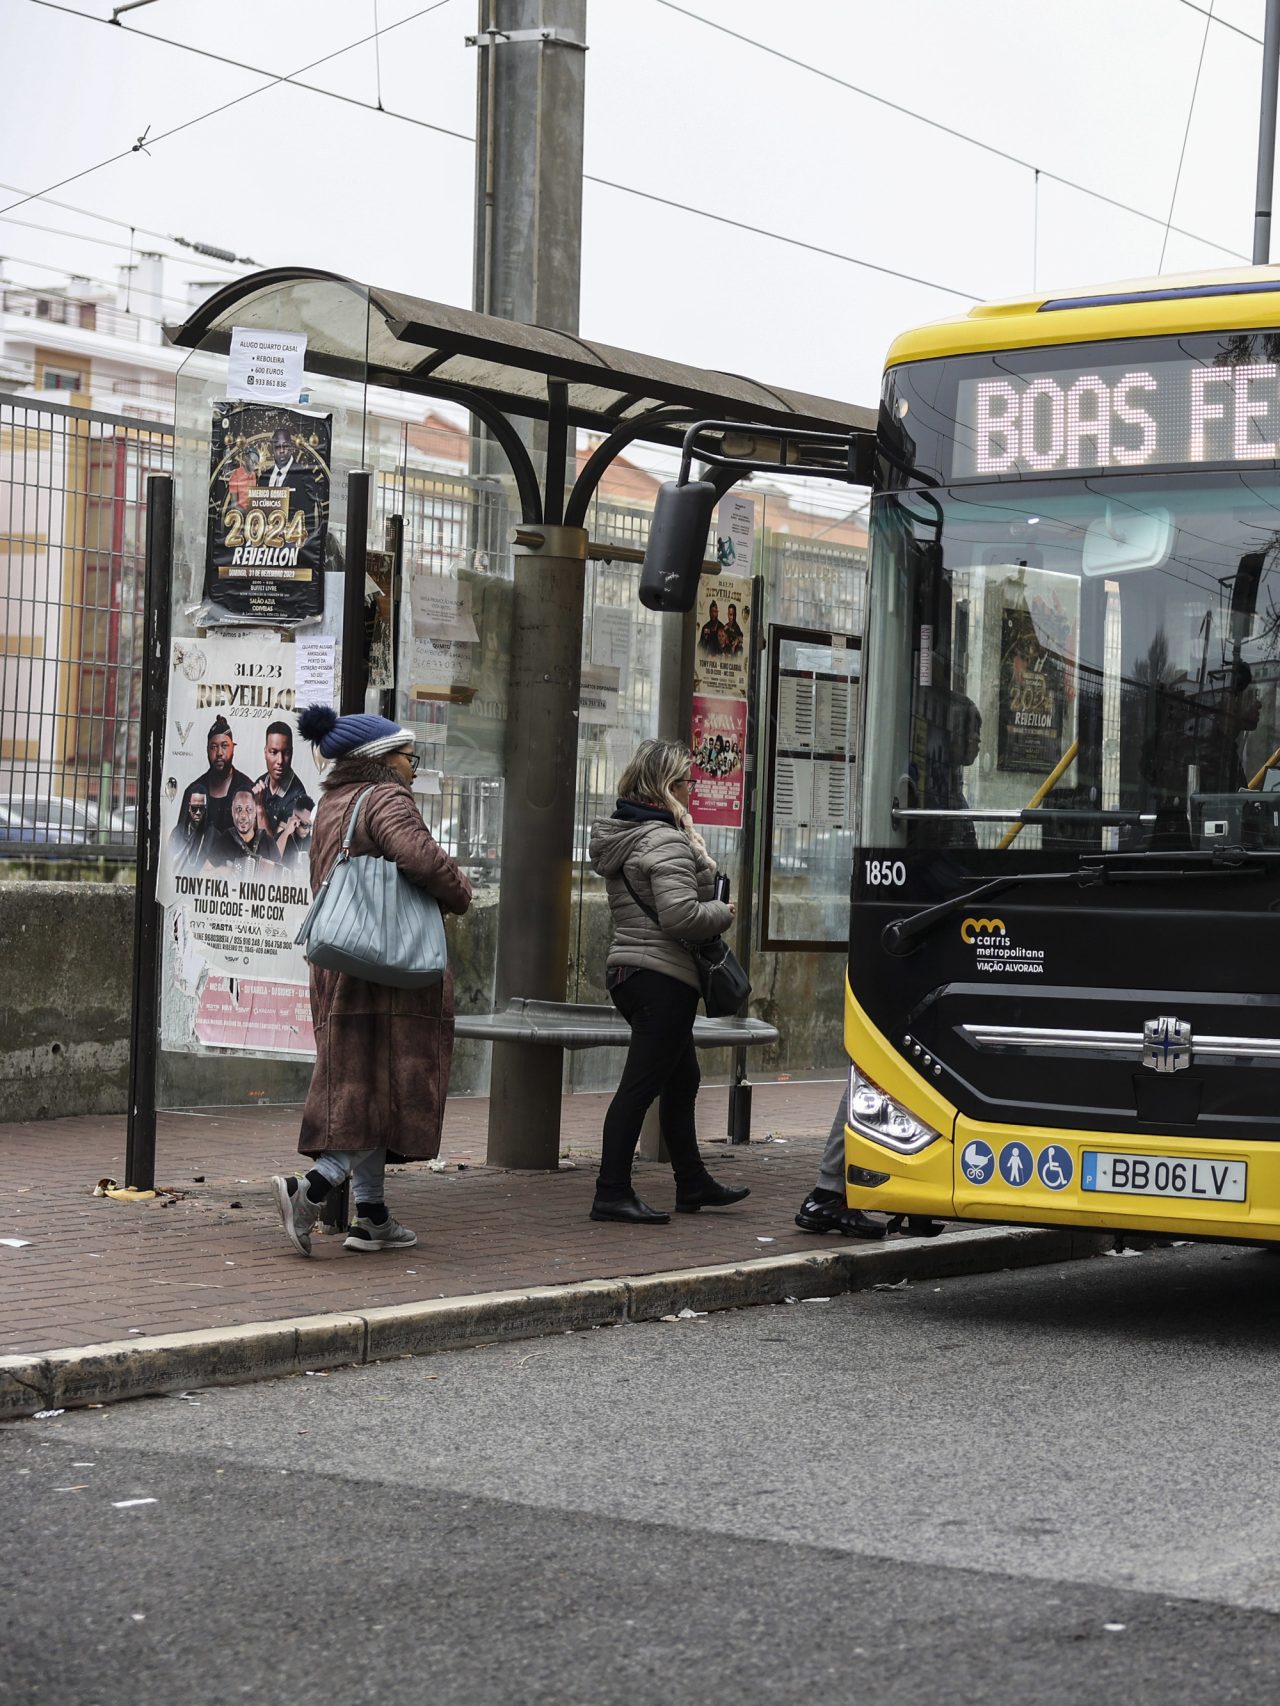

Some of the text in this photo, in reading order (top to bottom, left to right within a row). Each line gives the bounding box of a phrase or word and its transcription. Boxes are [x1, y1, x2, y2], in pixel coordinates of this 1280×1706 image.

[240, 341, 298, 352] ALUGO QUARTO CASAL
[256, 355, 285, 364] REBOLEIRA
[266, 368, 284, 376] EUROS
[976, 372, 1157, 472] BOAS
[224, 509, 308, 547] 2024
[234, 663, 282, 678] 31.12.23
[196, 683, 297, 713] REVEILLO
[229, 706, 273, 719] 2023-2024
[865, 861, 907, 885] 1850
[175, 875, 204, 895] TONY
[205, 878, 229, 898] FIKA
[239, 881, 265, 902] KINO
[267, 884, 309, 906] CABRAL
[194, 898, 210, 914] TIU
[209, 899, 219, 915] DI
[222, 901, 243, 917] CODE
[251, 904, 265, 920] MC
[267, 905, 285, 921] COX
[211, 922, 233, 932] RASTA
[977, 934, 1010, 946] carris
[976, 947, 1045, 958] metropolitana
[977, 961, 1044, 973] VIAÇÃO ALVORADA
[1086, 1175, 1093, 1184] P
